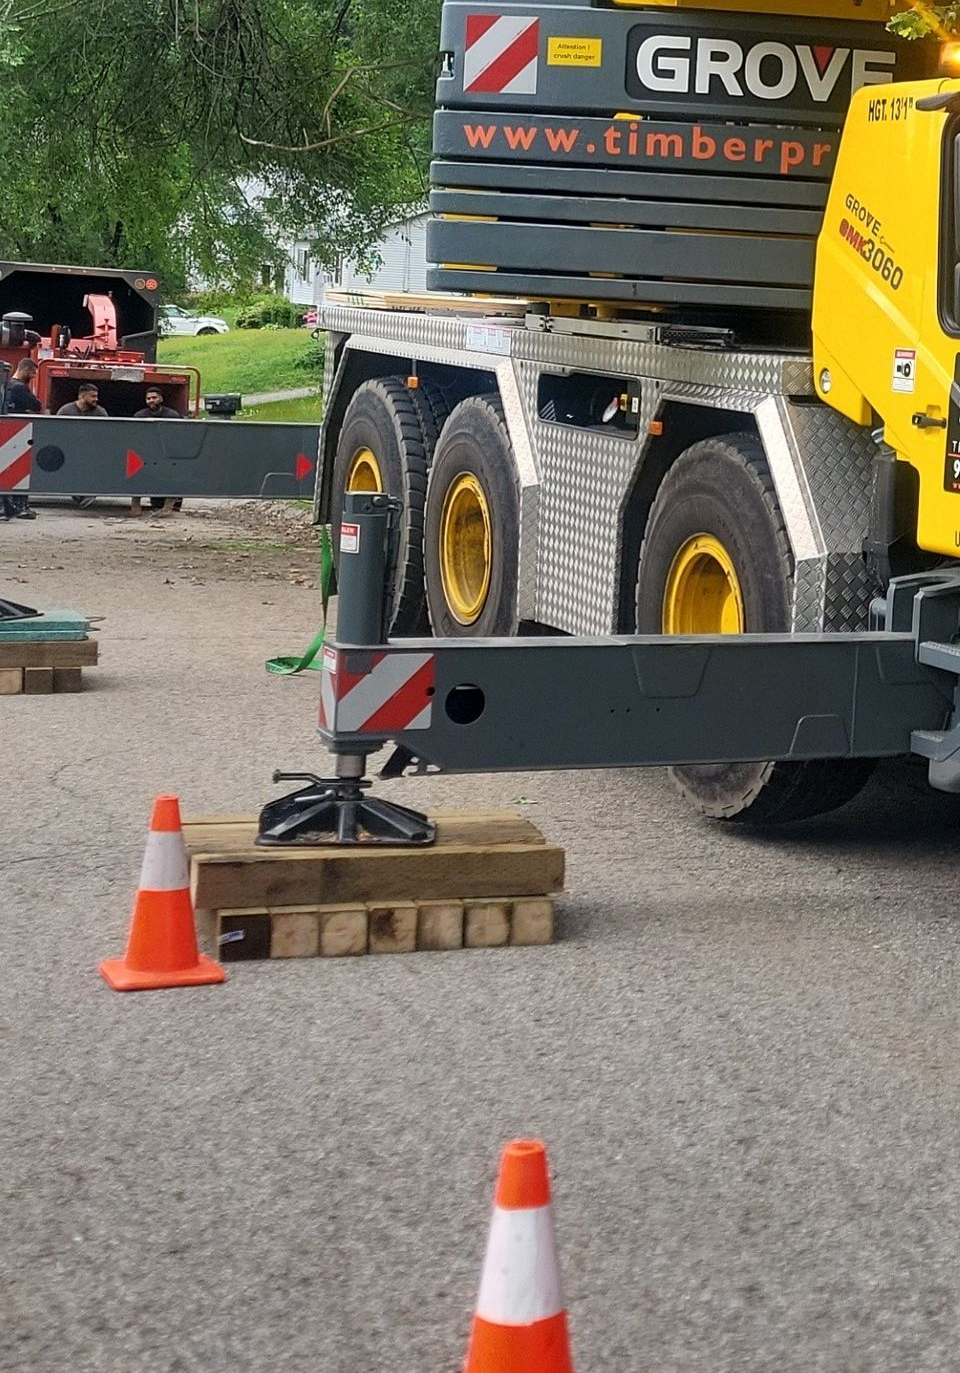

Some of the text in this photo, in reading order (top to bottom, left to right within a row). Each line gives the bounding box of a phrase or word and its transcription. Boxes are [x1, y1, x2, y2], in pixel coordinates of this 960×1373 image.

[636, 34, 896, 102] GROVE
[868, 98, 887, 122] HGT.
[463, 121, 831, 174] www.timberpr
[845, 193, 882, 237] GROVE
